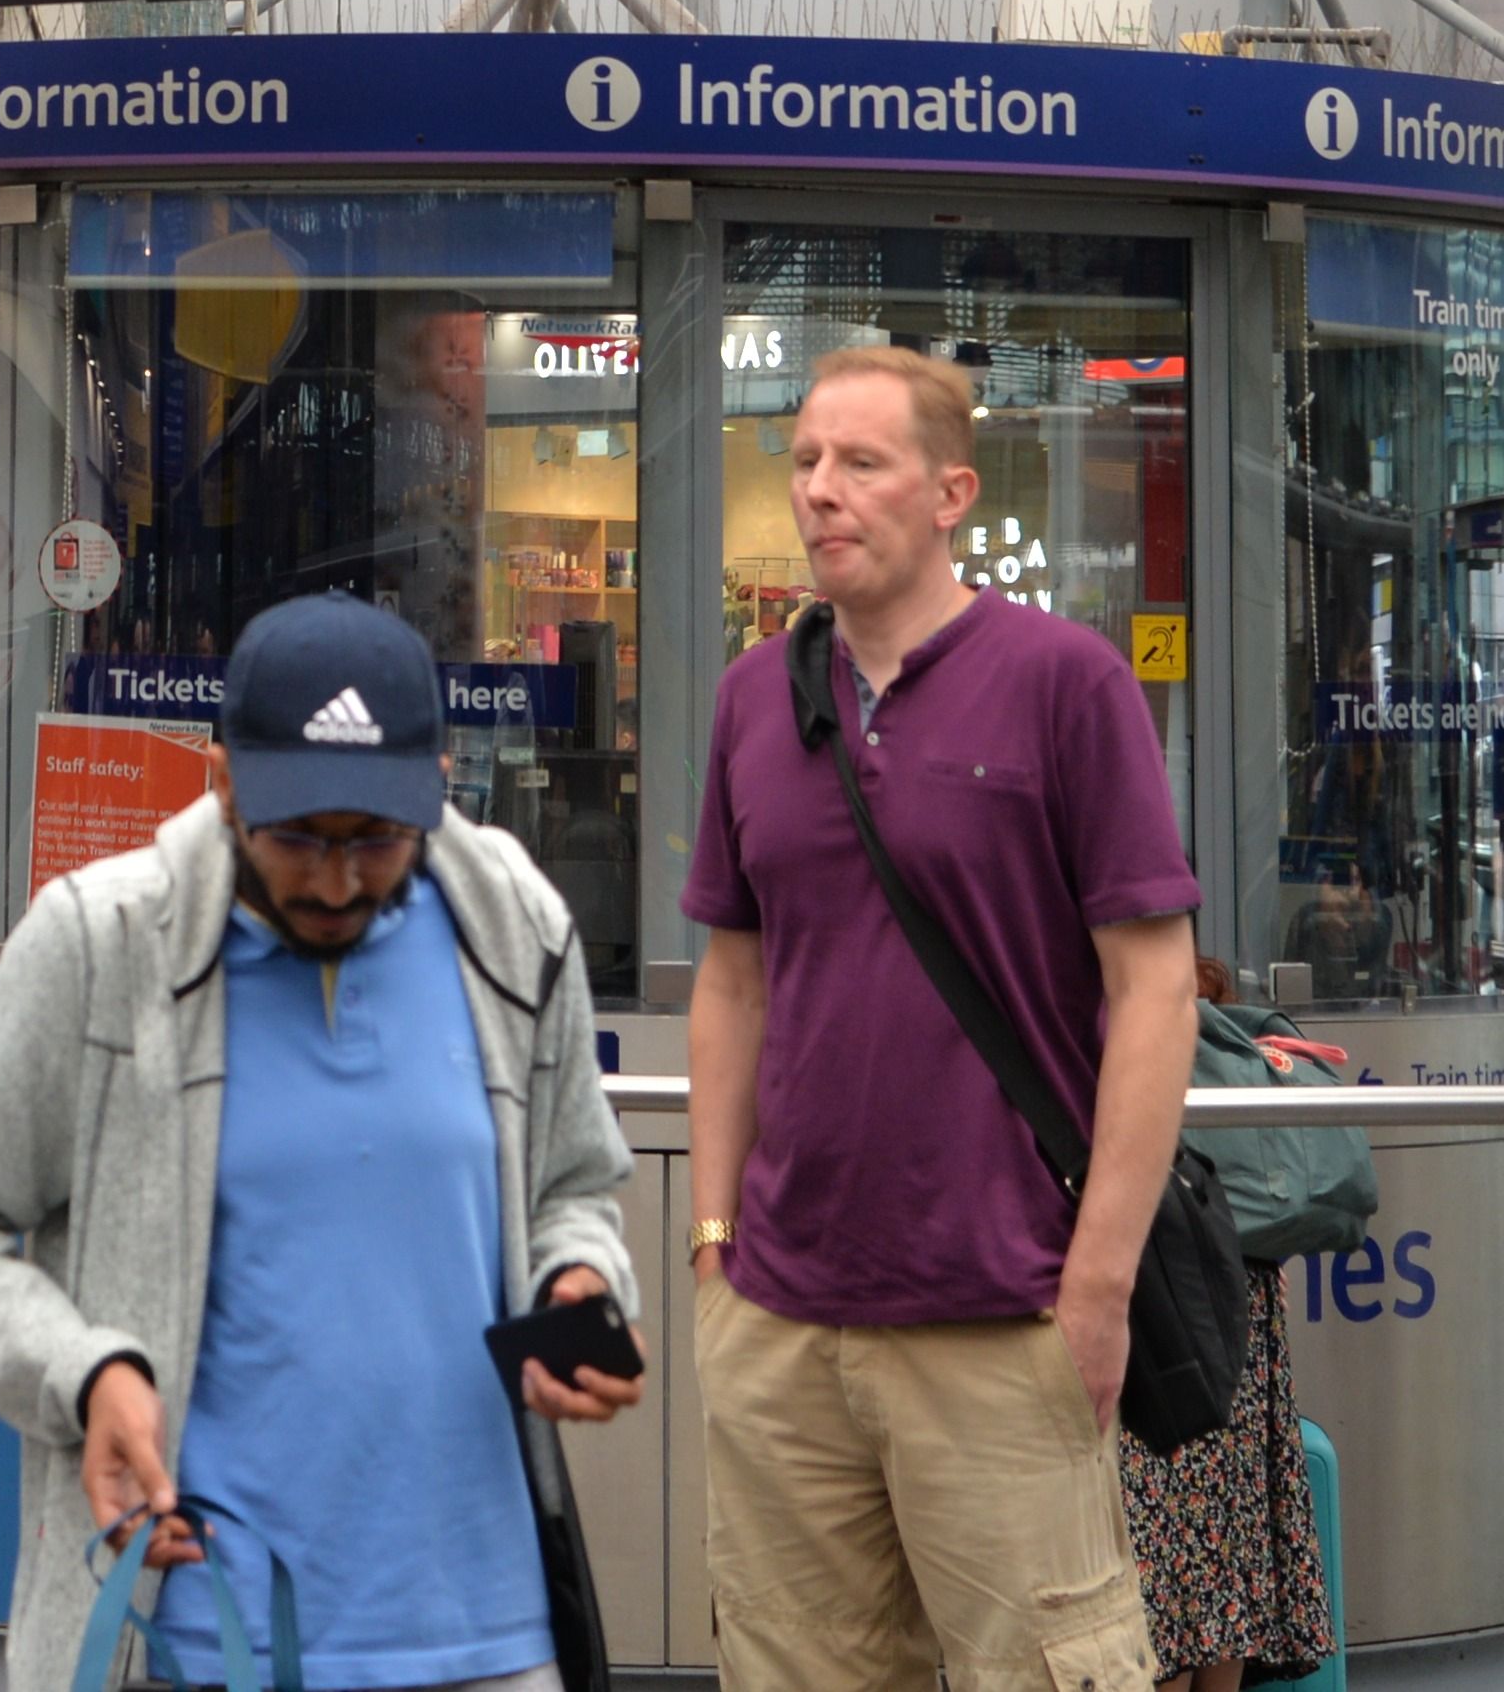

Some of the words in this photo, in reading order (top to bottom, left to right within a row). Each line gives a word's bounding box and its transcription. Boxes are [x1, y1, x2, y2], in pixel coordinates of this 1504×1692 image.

[677, 63, 1080, 139] Information
[1412, 289, 1476, 332] Train
[1451, 344, 1501, 385] only
[108, 668, 225, 705] Tickets
[448, 677, 528, 712] here
[1330, 691, 1435, 732] Tickets
[1441, 702, 1481, 731] are
[45, 755, 85, 775] Staff
[88, 759, 145, 782] safety:
